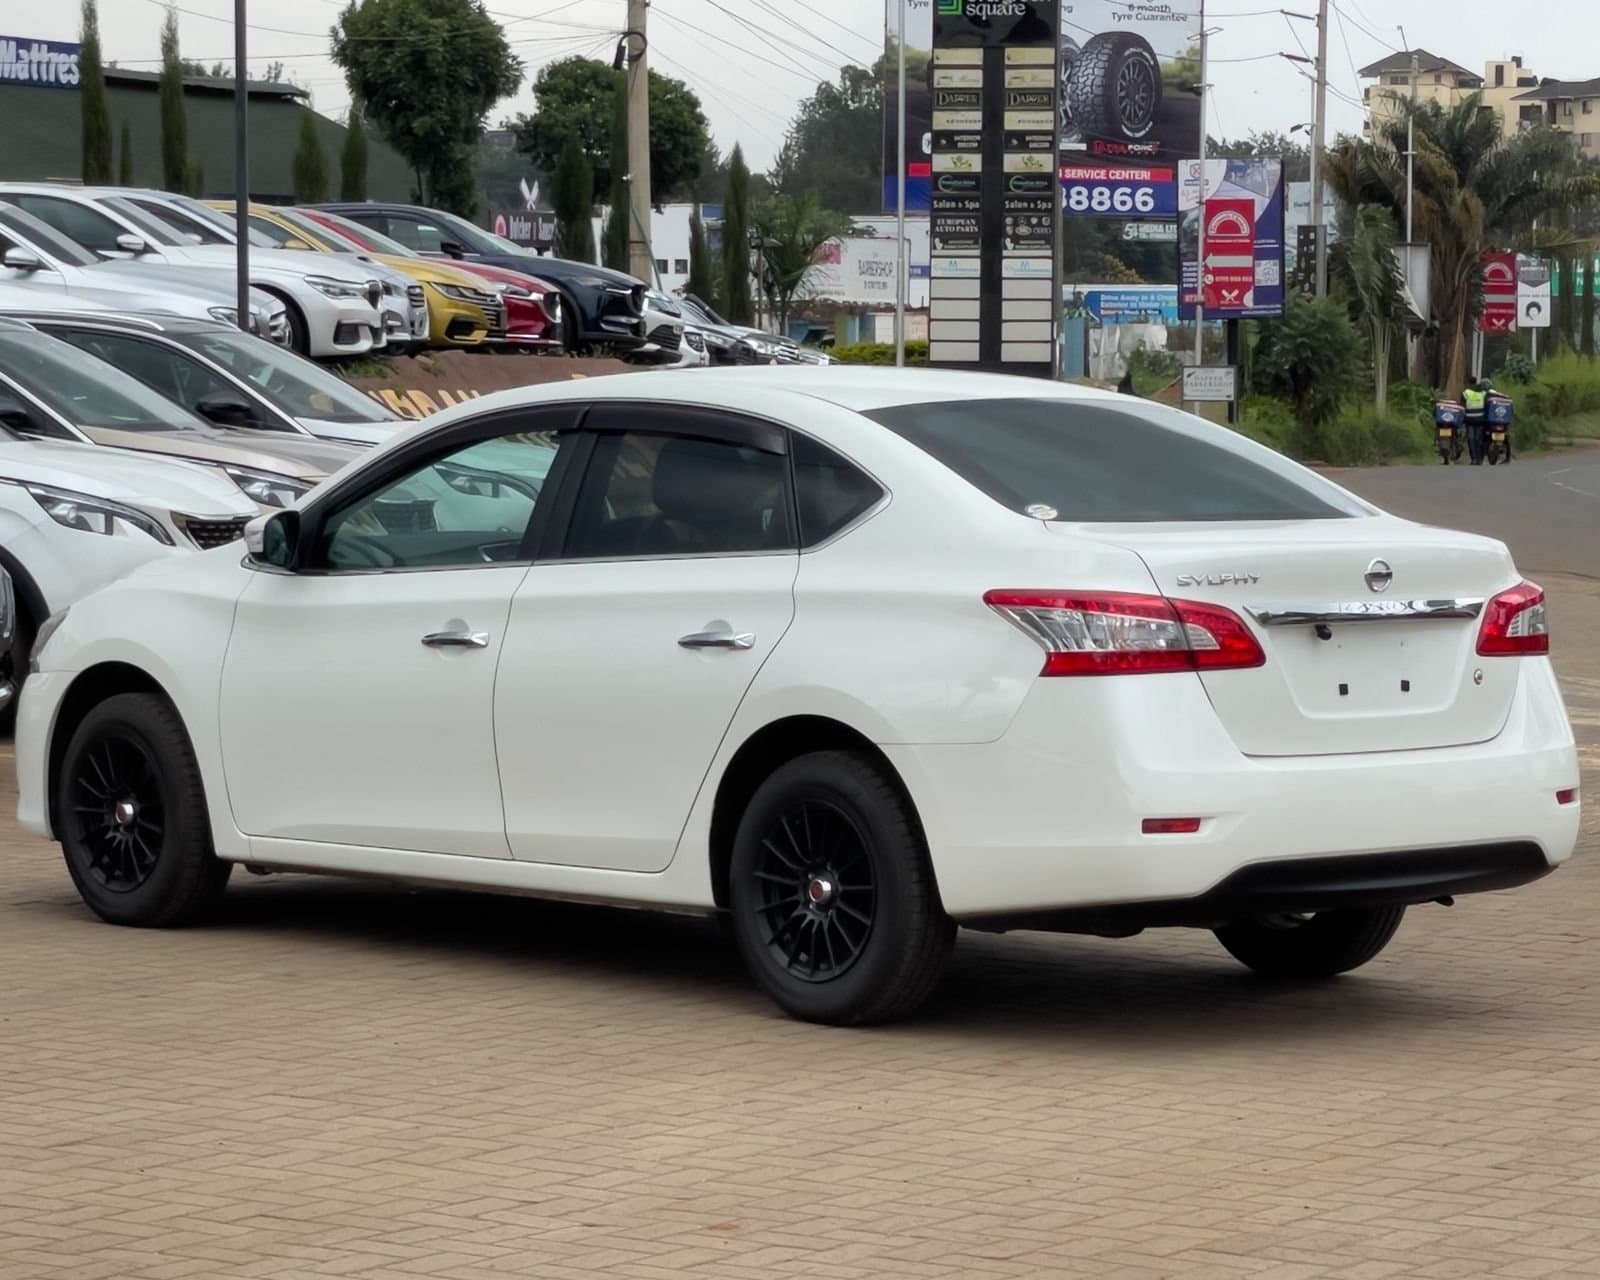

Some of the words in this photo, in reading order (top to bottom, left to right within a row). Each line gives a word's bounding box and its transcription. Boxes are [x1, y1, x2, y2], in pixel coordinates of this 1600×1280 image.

[966, 3, 1026, 20] square
[1137, 4, 1171, 13] month
[1112, 12, 1133, 22] Tyre
[1136, 12, 1187, 21] Guarantee
[1064, 168, 1107, 180] SERVICE
[1109, 169, 1151, 180] CENTER!
[1062, 186, 1154, 212] 8866
[933, 200, 956, 209] Salon
[964, 200, 980, 210] Spa
[1005, 200, 1028, 209] Salon
[1037, 200, 1052, 210] Spa
[935, 225, 956, 233] AUTO
[957, 225, 979, 233] PARTS
[1177, 570, 1260, 587] SYLPHY
